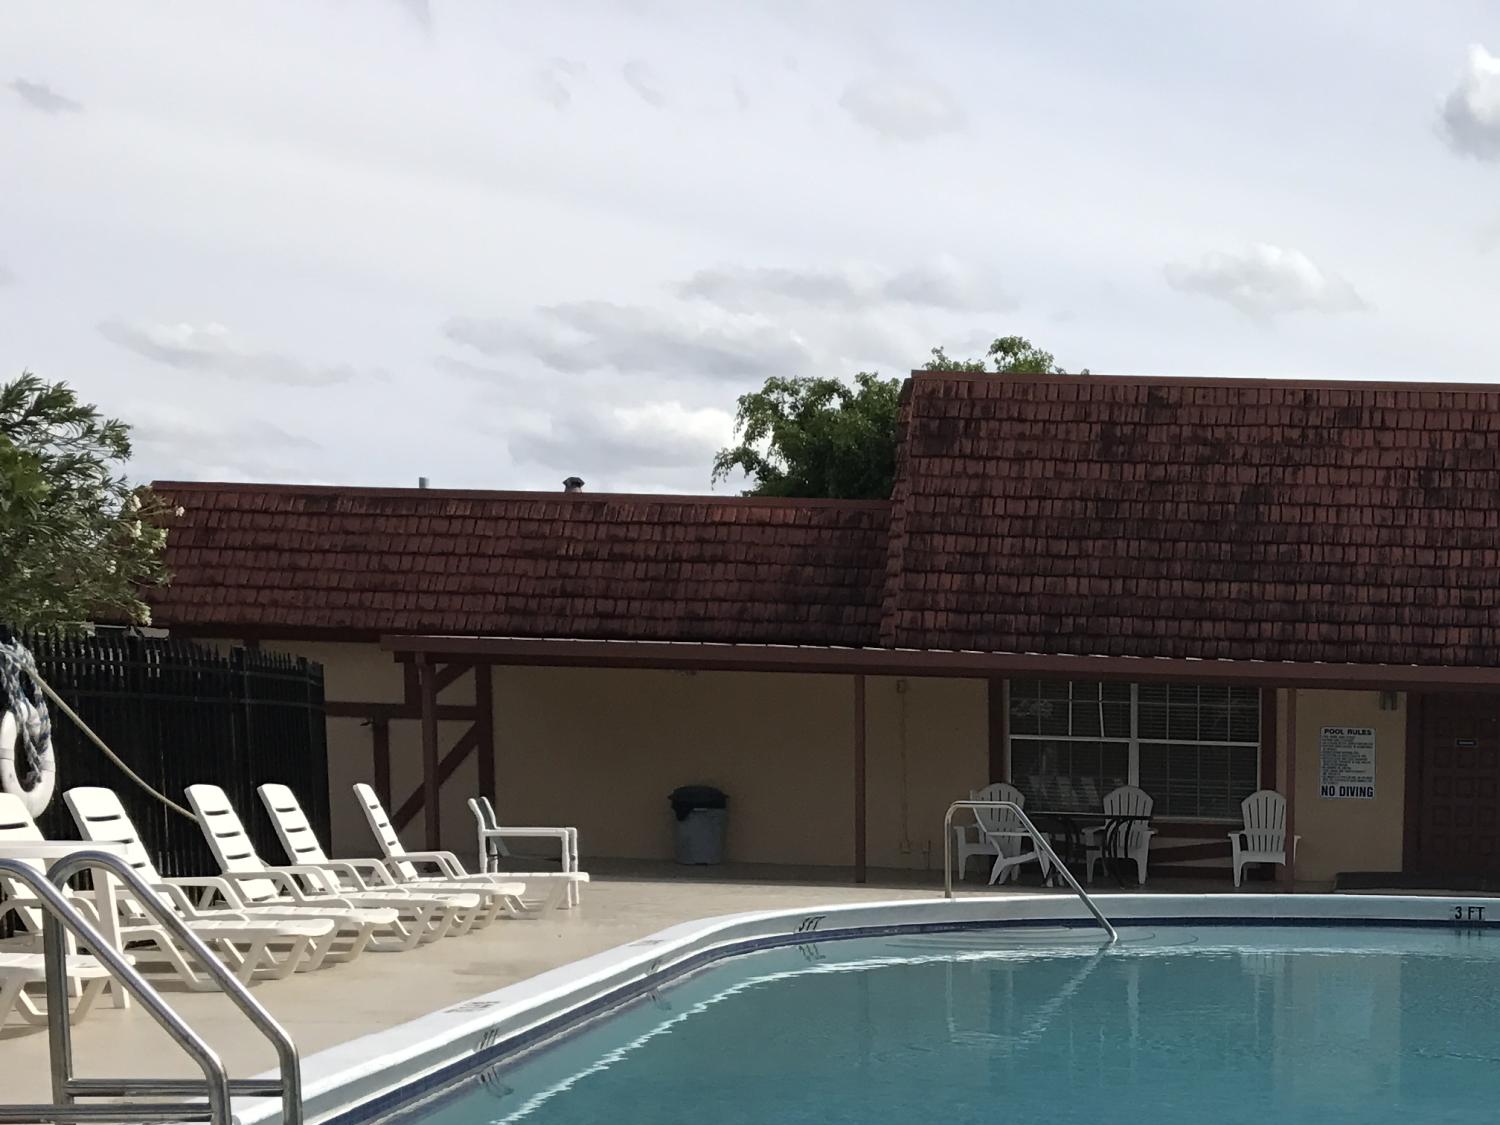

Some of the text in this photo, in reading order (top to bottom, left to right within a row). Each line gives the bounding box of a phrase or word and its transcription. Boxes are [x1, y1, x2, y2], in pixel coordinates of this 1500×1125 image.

[1321, 785, 1374, 798] NO DIVING
[1454, 906, 1486, 921] 3 FT
